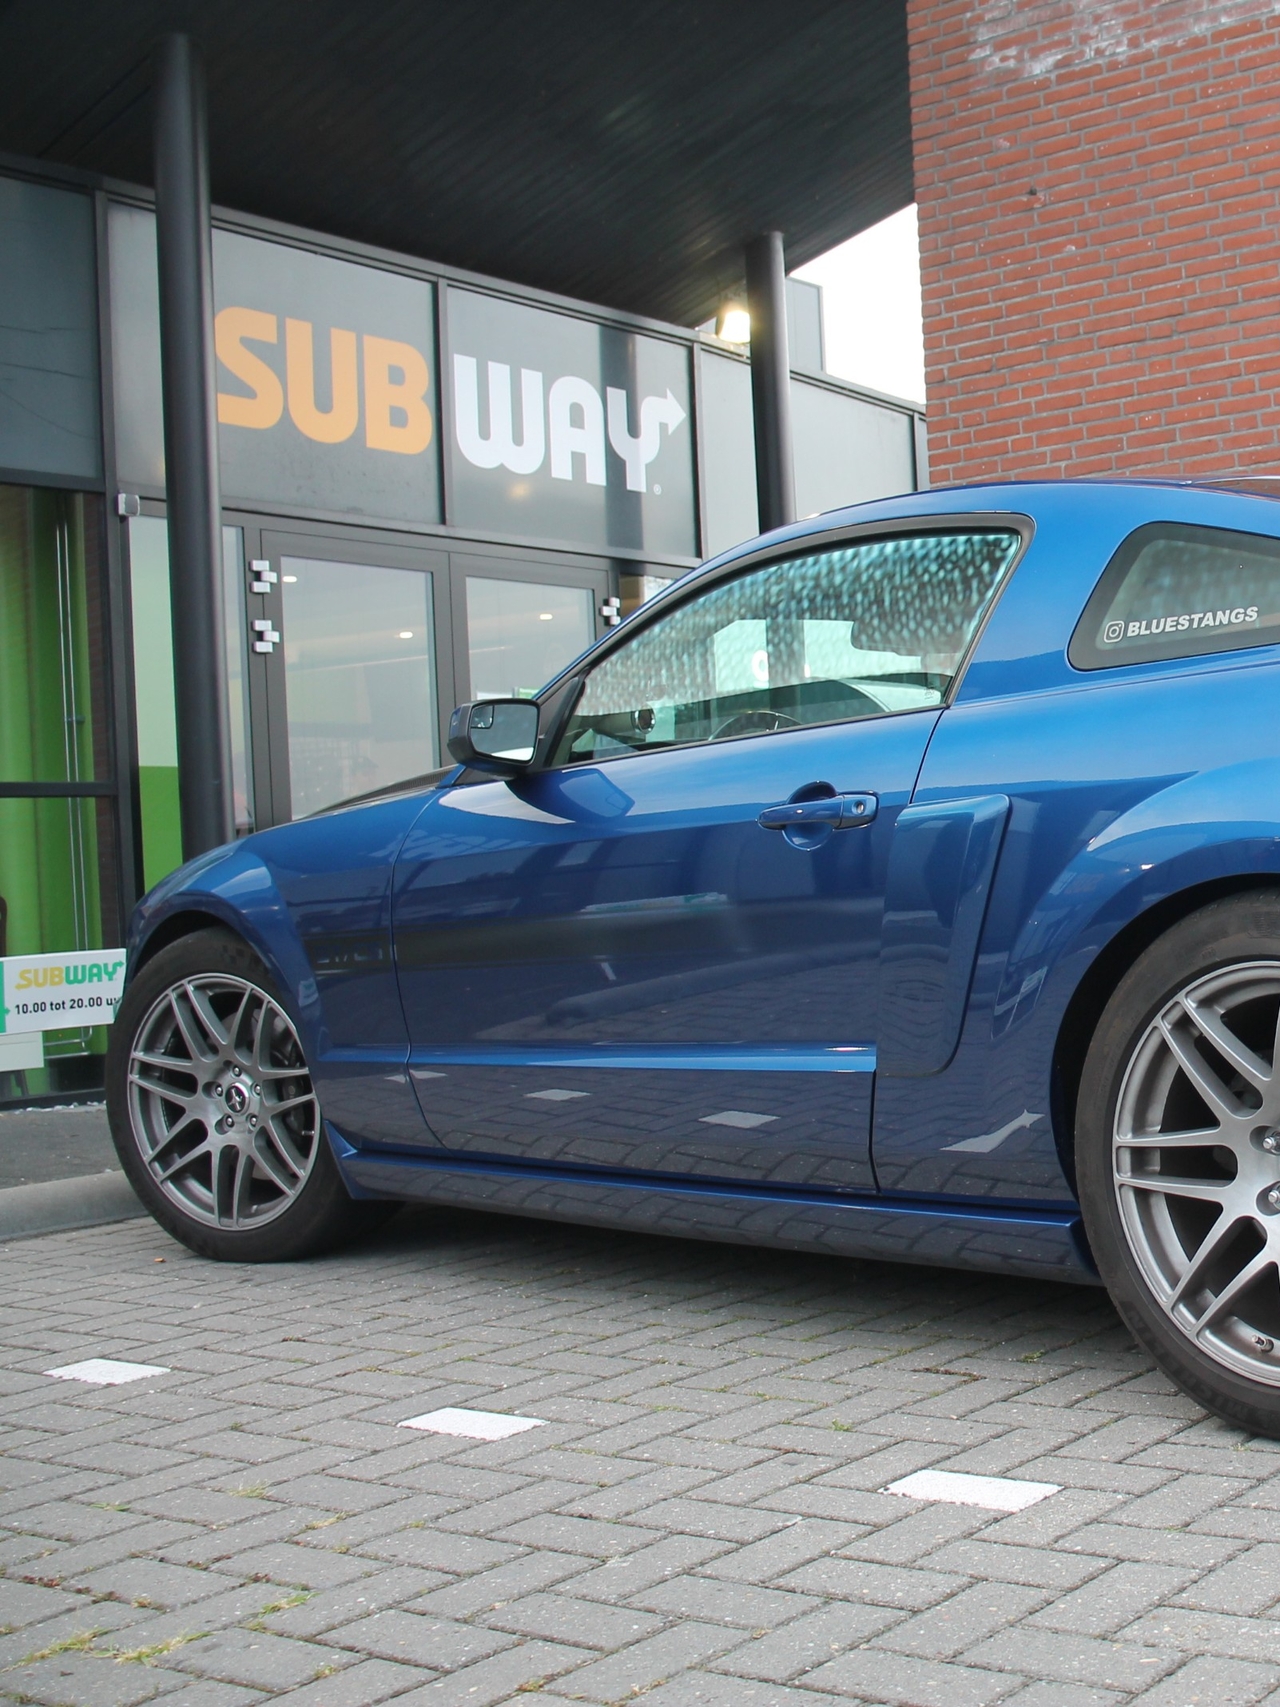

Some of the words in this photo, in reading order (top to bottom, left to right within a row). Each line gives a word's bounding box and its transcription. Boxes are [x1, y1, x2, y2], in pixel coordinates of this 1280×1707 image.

[1127, 606, 1259, 637] BLUESTANGS
[15, 960, 124, 990] SUBWAY
[15, 1001, 46, 1014] 10.00
[50, 1000, 66, 1011] tot
[69, 996, 102, 1009] 20.00
